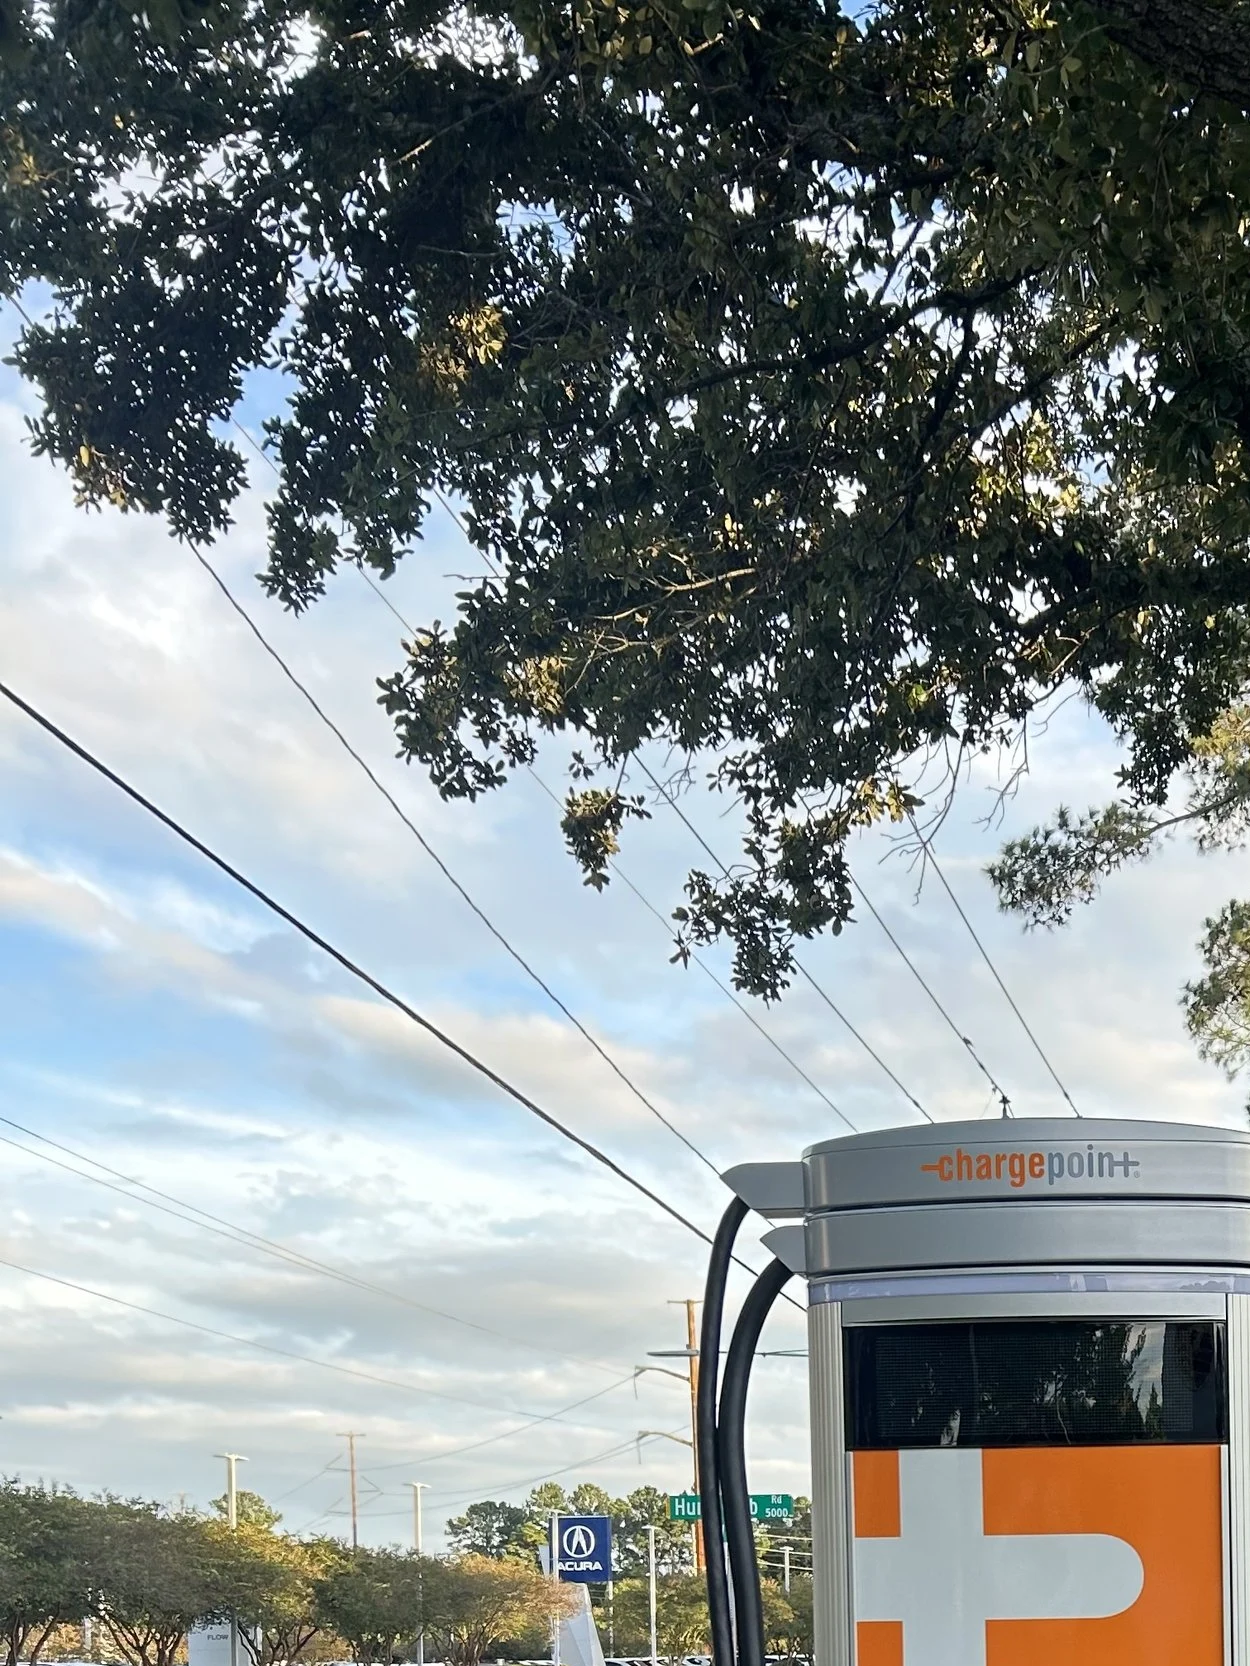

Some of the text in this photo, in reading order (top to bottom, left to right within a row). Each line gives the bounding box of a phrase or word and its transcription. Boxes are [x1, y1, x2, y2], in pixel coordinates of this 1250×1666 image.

[771, 1494, 783, 1505] Rd
[765, 1507, 789, 1518] 5000
[558, 1561, 603, 1572] ACURA
